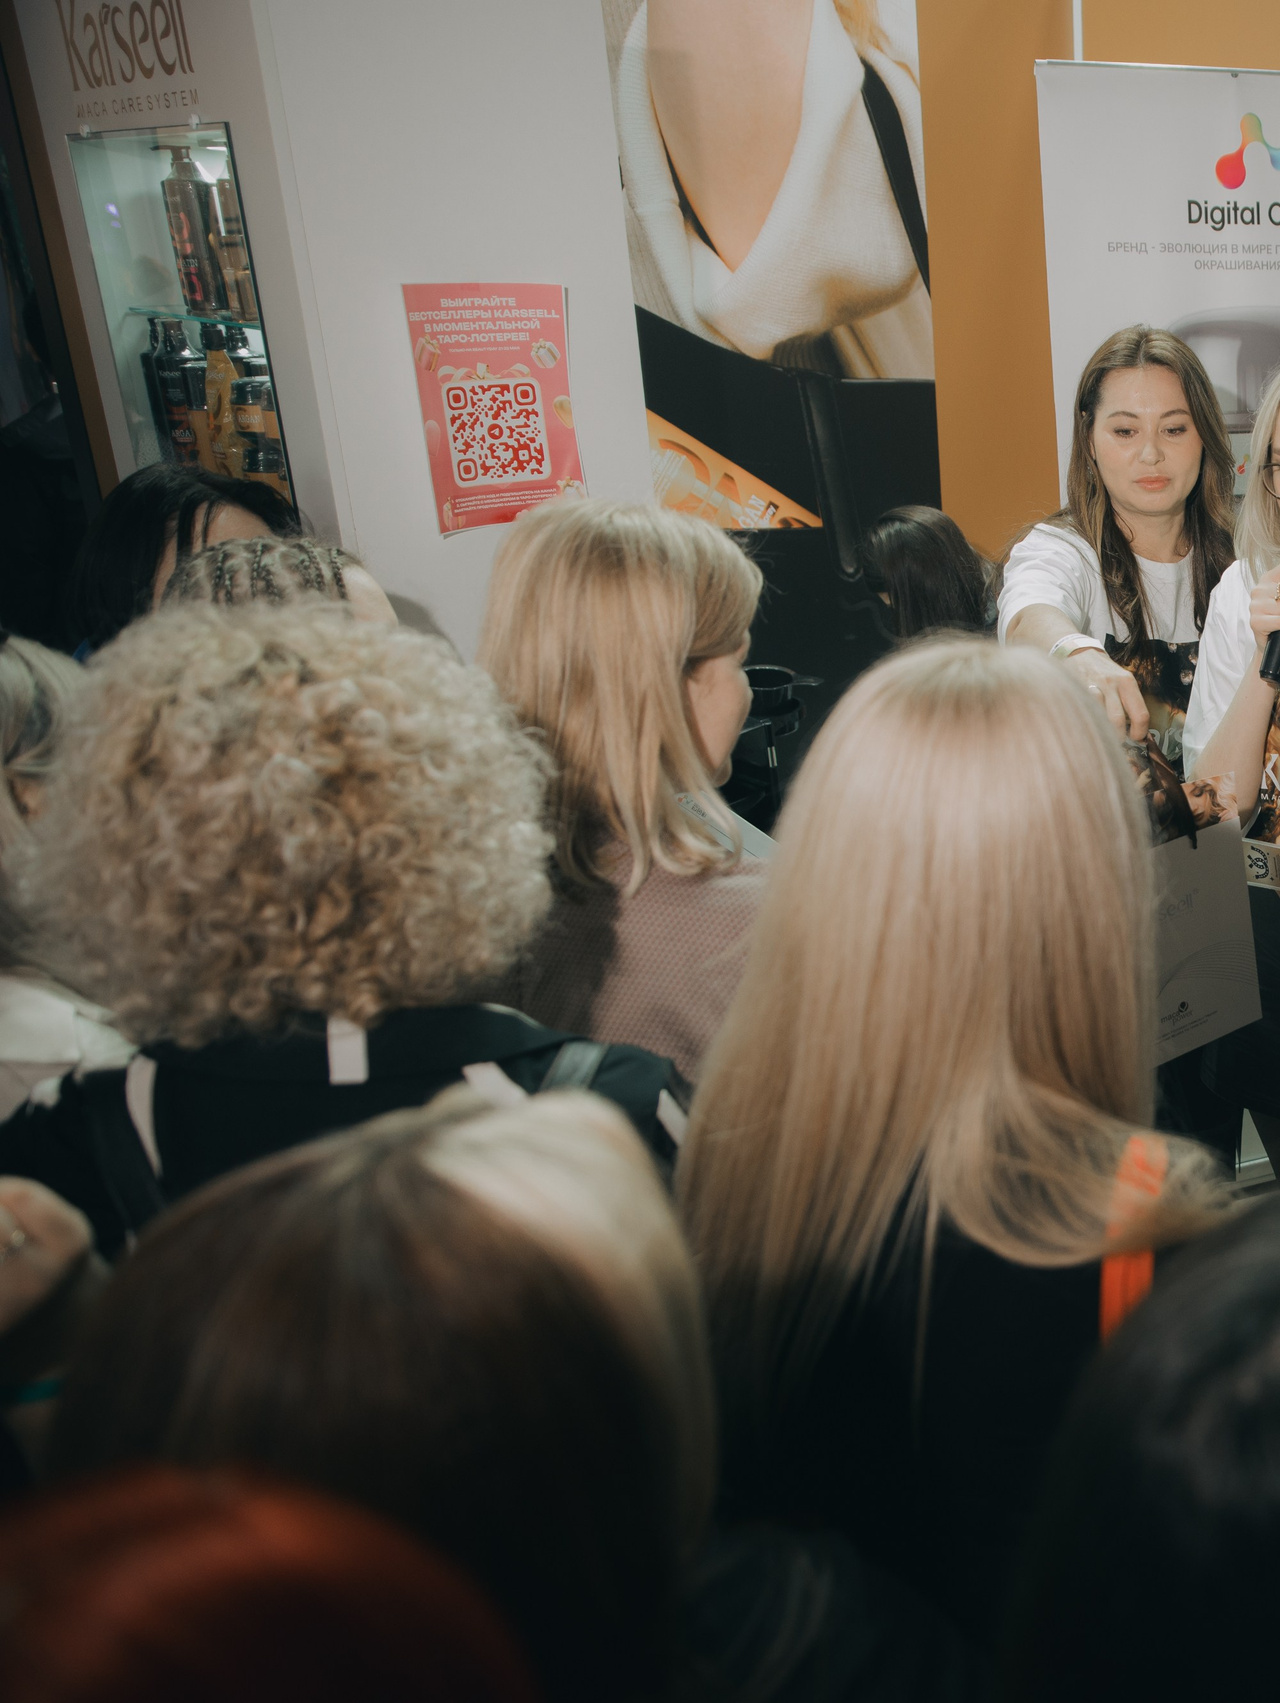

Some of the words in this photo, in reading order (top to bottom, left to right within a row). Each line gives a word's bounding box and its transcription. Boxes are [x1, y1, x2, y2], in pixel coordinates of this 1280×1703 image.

[57, 0, 195, 91] Karseell
[77, 101, 108, 119] MACA
[112, 96, 144, 115] CARE
[147, 88, 200, 110] SYSTEM
[1187, 200, 1261, 231] Digital
[1107, 242, 1149, 255] БРЕНД
[1159, 242, 1228, 256] ЭВОЛЮЦИЯ
[1231, 243, 1239, 254] В
[1242, 244, 1272, 255] МИРЕ
[440, 295, 516, 308] ВЫИГРАЙТЕ
[408, 309, 492, 322] БЕСТСЕЛЛЕРЫ
[494, 308, 560, 318] KARSEELL
[424, 323, 432, 333] В
[433, 318, 541, 332] МОМЕНТАЛЬНОЙ
[437, 332, 530, 344] ТАРО-ЛОТЕРЕЕ!
